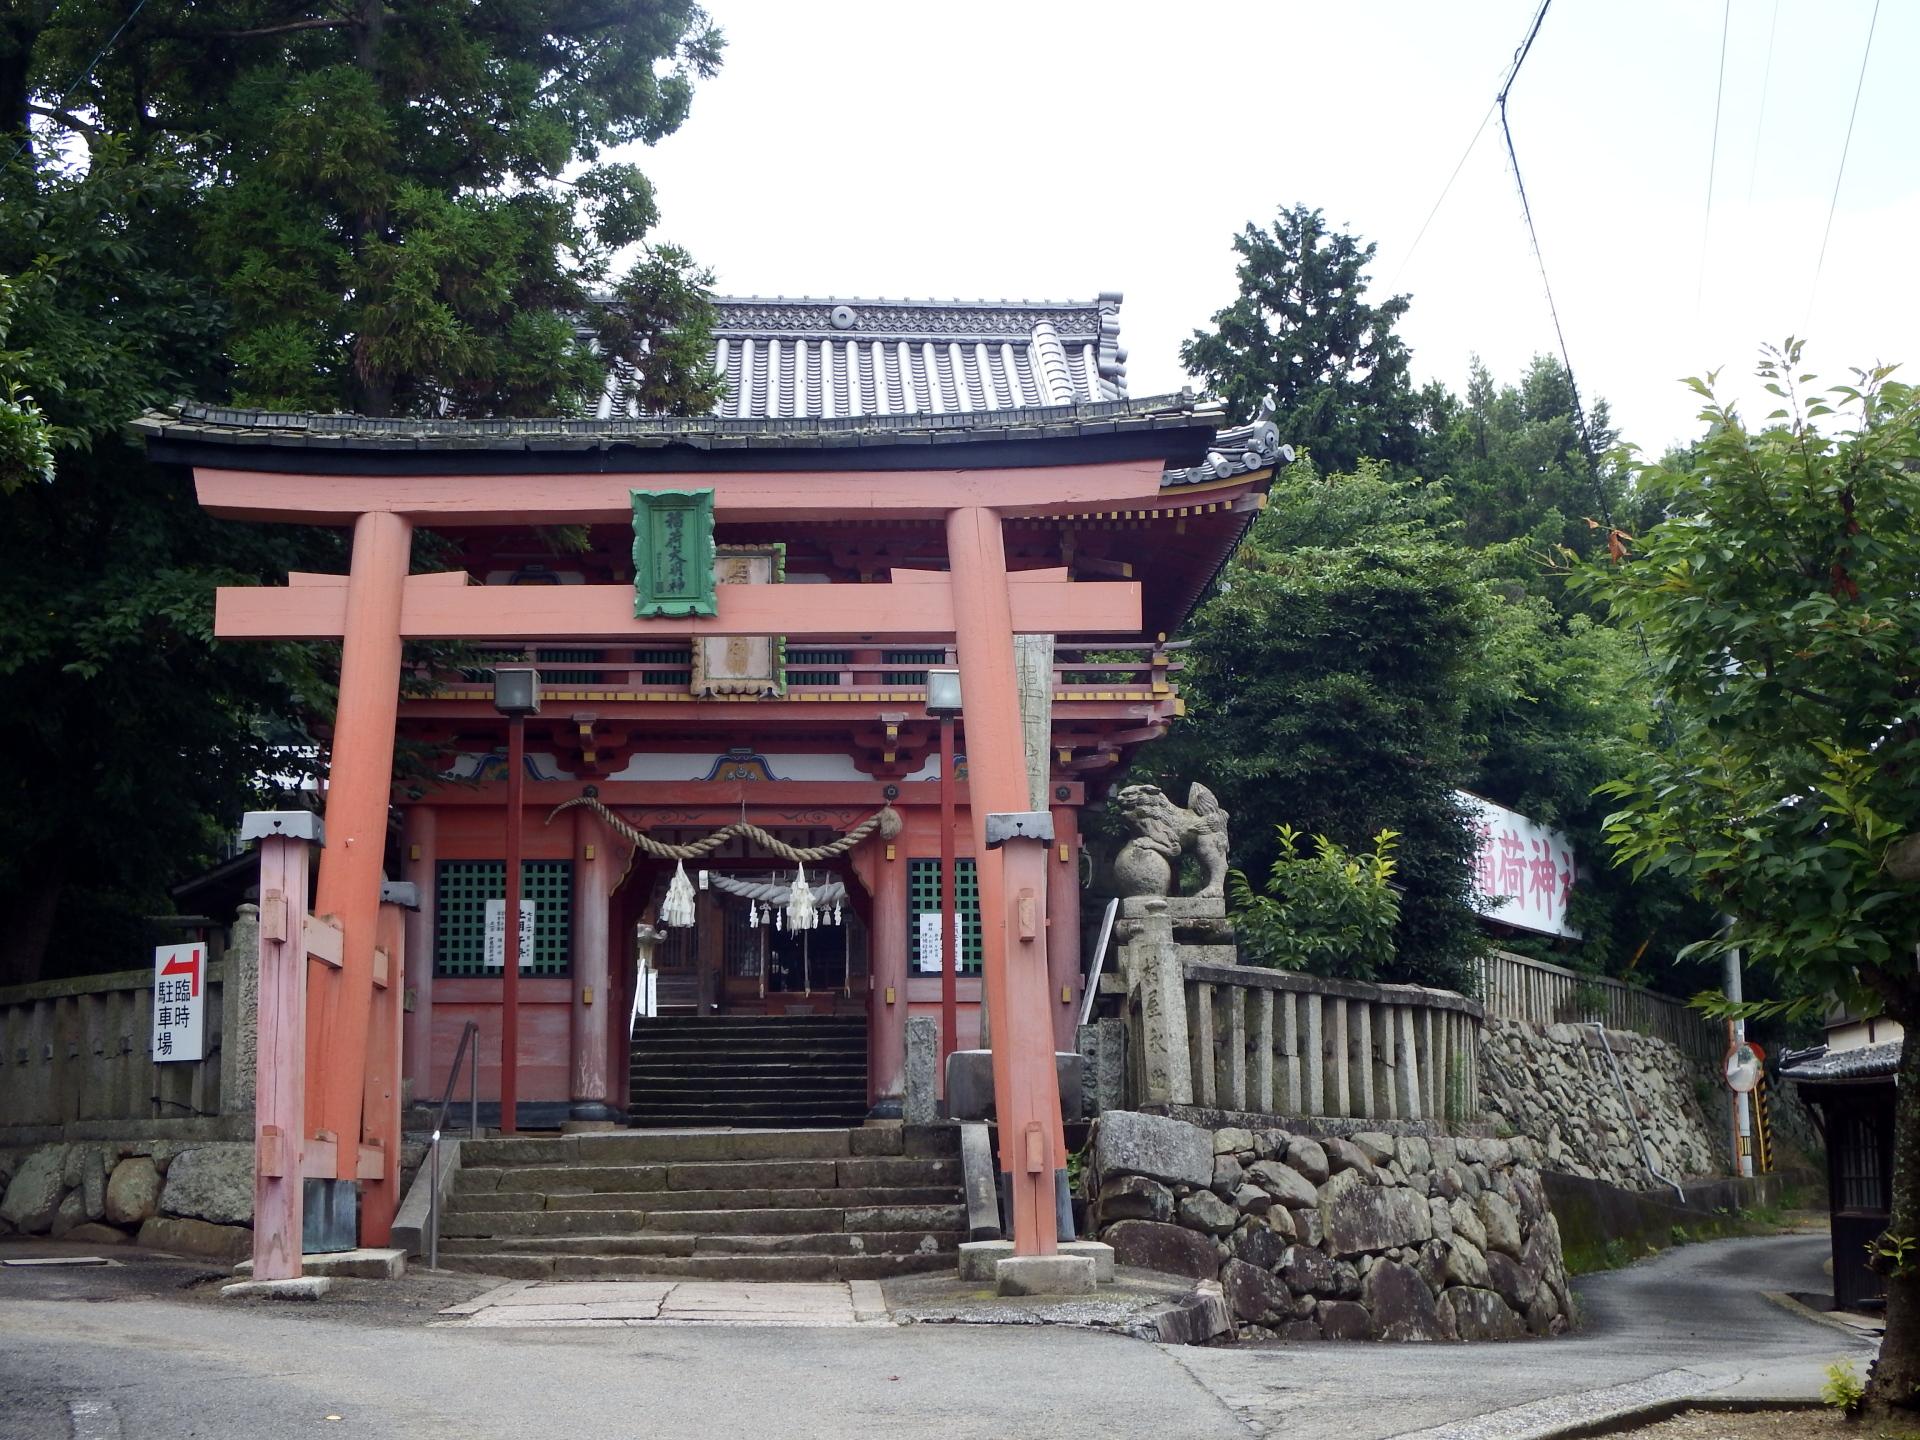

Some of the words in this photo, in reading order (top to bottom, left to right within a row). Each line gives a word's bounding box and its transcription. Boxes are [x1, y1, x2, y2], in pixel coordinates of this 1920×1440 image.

[157, 981, 174, 1055] 駐車場
[175, 979, 191, 1028] 臨時
